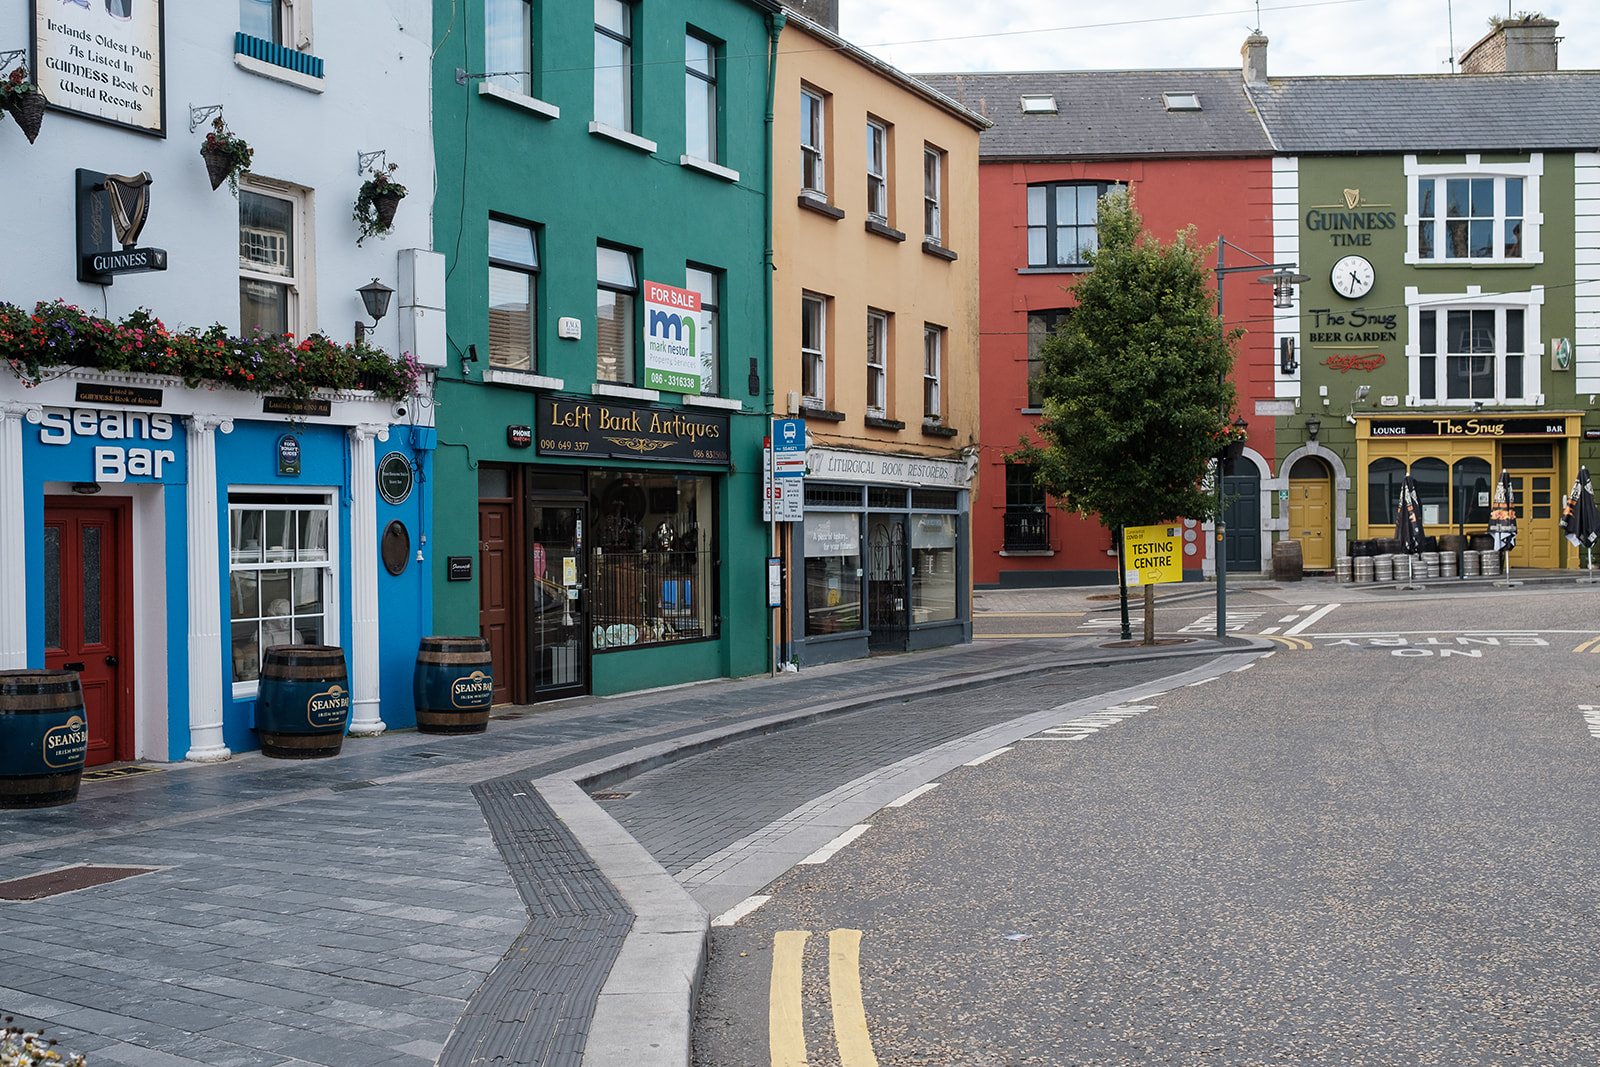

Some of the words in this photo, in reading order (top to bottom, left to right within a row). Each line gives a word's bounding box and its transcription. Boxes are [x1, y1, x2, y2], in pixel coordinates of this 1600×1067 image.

[47, 18, 92, 42] Irelands
[95, 34, 128, 54] Oldest
[131, 45, 152, 61] Pub
[69, 44, 84, 58] As
[88, 50, 120, 69] Listed
[124, 61, 134, 73] In
[45, 56, 109, 84] GUINNESS
[112, 75, 138, 93] Book
[142, 84, 154, 97] Of
[60, 79, 96, 99] World
[99, 89, 143, 112] Records
[1306, 209, 1396, 231] GUINNESS
[1330, 233, 1372, 247] TIME
[93, 252, 147, 271] GUINNESS
[651, 287, 670, 303] FOR
[671, 290, 695, 308] SALE
[1308, 308, 1346, 328] The
[1348, 307, 1397, 330] Snug
[649, 340, 667, 352] mark
[1309, 332, 1342, 343] BEER
[1344, 332, 1397, 342] GARDEN
[649, 352, 673, 367] Property
[674, 356, 697, 369] Services
[651, 372, 663, 384] 086
[667, 375, 695, 388] 3316338
[40, 405, 173, 445] Seans
[551, 403, 592, 432] Left
[598, 407, 642, 433] Bank
[649, 412, 720, 443] Antiques
[1373, 427, 1406, 435] LOUNGE
[1432, 419, 1463, 436] The
[1464, 418, 1505, 436] Snug
[1546, 425, 1563, 433] BAR
[512, 429, 531, 438] PHONE
[540, 439, 555, 449] 090
[557, 440, 572, 450] 649
[574, 441, 590, 451] 3377
[692, 449, 705, 459] 086
[94, 445, 175, 483] Bar
[827, 455, 876, 475] LITURGICAL
[881, 461, 904, 476] BOOK
[1132, 541, 1173, 555] TESTING
[1134, 555, 1172, 569] CENTRE
[1324, 637, 1549, 646] ENTRY
[1391, 649, 1482, 657] NO
[455, 683, 482, 694] SEAN'S
[312, 699, 340, 712] SEAN'S
[48, 732, 80, 749] SEAN'S
